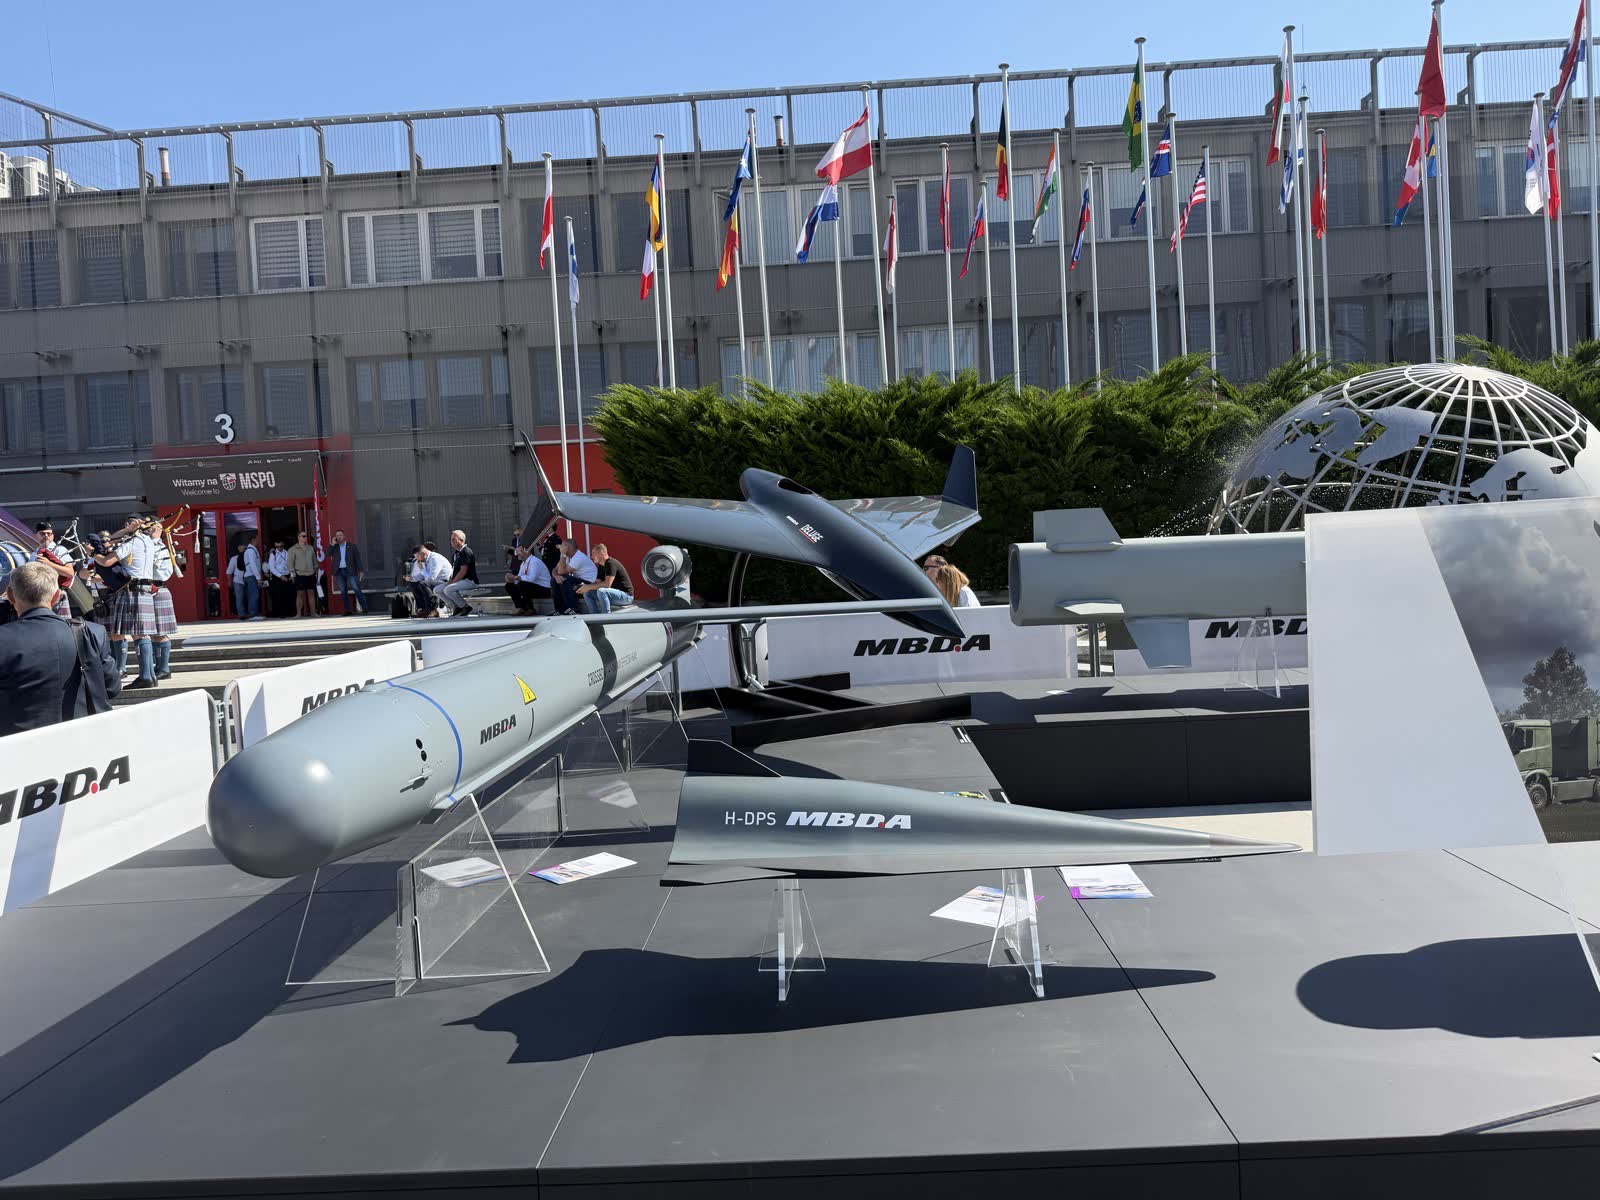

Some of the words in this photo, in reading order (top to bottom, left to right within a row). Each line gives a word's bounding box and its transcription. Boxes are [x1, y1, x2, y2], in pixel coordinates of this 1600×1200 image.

[214, 413, 235, 444] 3
[172, 478, 205, 488] Witamy
[207, 478, 218, 486] na
[239, 471, 276, 490] MSPO
[181, 488, 212, 496] Welcome
[799, 523, 824, 543] DELUGE
[1204, 617, 1308, 639] MBD
[479, 713, 518, 746] MBDA
[724, 810, 777, 826] H-DPS
[785, 811, 912, 829] MBDA
